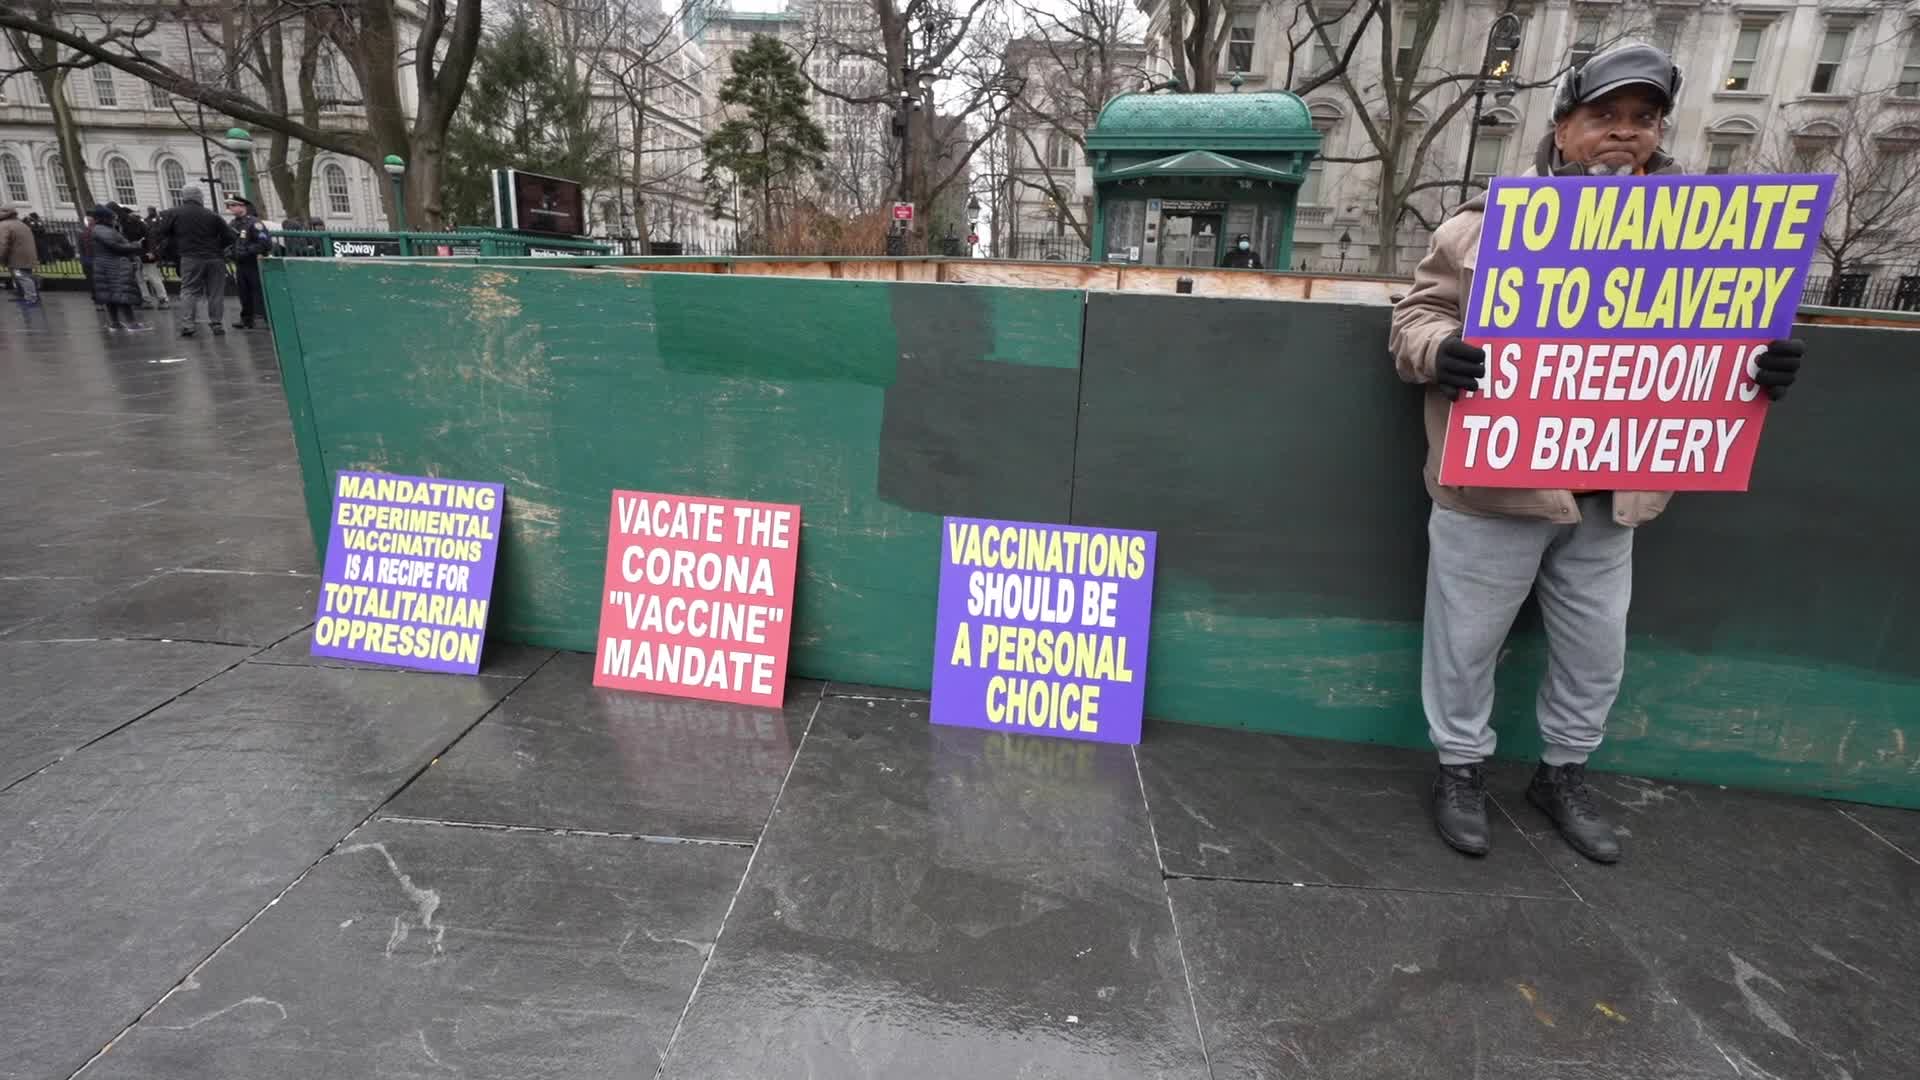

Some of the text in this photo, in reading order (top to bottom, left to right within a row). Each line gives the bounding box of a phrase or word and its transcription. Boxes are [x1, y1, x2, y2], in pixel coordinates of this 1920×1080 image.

[1496, 185, 1819, 251] TO MANDATE
[333, 241, 375, 256] Subway
[1479, 266, 1796, 329] IS TO SLAVERY
[1466, 343, 1768, 402] AS FREEDOM IS
[1462, 415, 1746, 473] TO BRAVERY
[338, 475, 496, 511] MANDATING
[337, 502, 494, 540] EXPERIMENTAL
[343, 528, 482, 562] VACCINATIONS
[618, 496, 791, 549] VACATE THE
[344, 553, 470, 592] IS A RECIPE FOR
[621, 545, 774, 597] CORONA
[949, 523, 1146, 580] VACCINATIONS
[324, 582, 487, 630] TOTALITARIAN
[610, 590, 784, 644] "VACCINE"
[967, 570, 1119, 628] SHOULD BE
[315, 616, 480, 664] OPPRESSION
[602, 637, 775, 695] MANDATE
[951, 621, 1133, 683] A PERSONAL
[985, 675, 1100, 733] CHOICE
